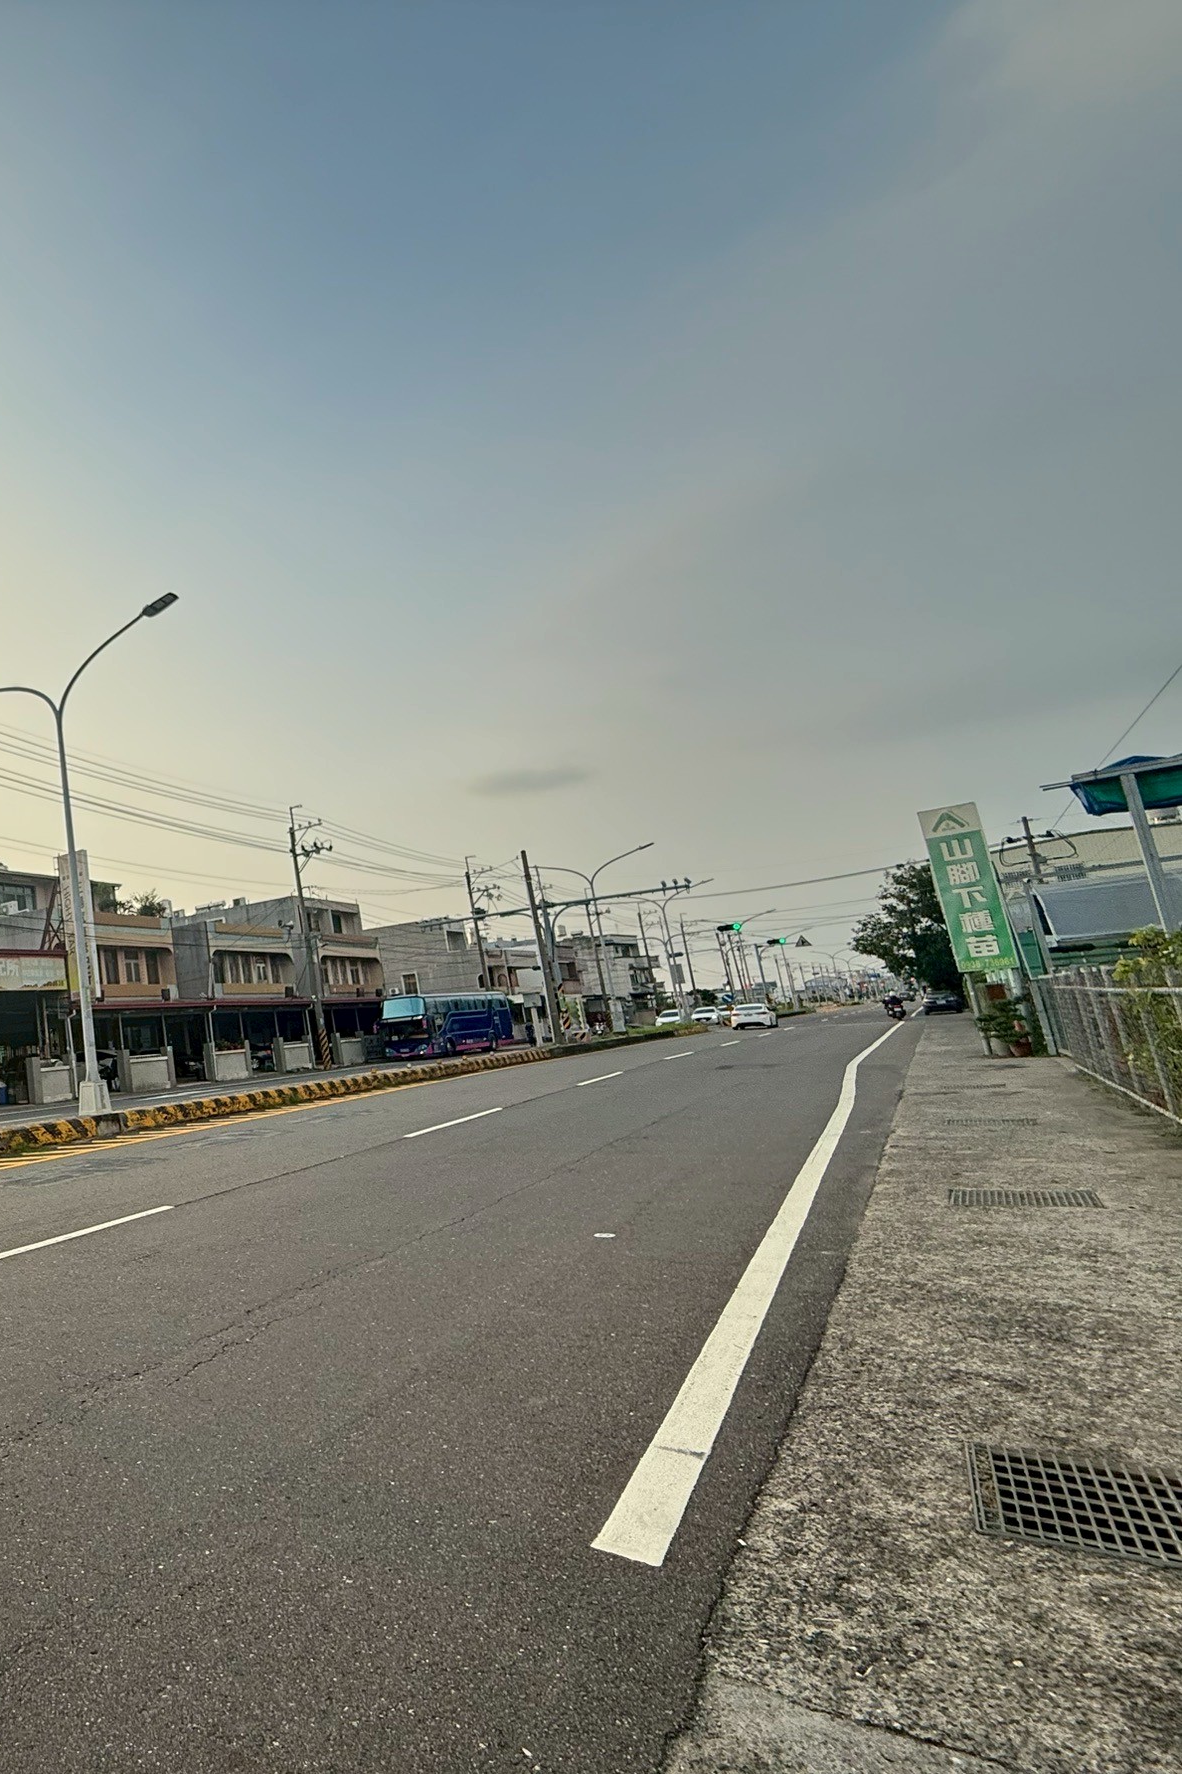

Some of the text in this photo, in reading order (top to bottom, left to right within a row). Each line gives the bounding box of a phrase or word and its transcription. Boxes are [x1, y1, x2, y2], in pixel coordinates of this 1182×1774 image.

[939, 838, 1001, 958] 山腳下種苗
